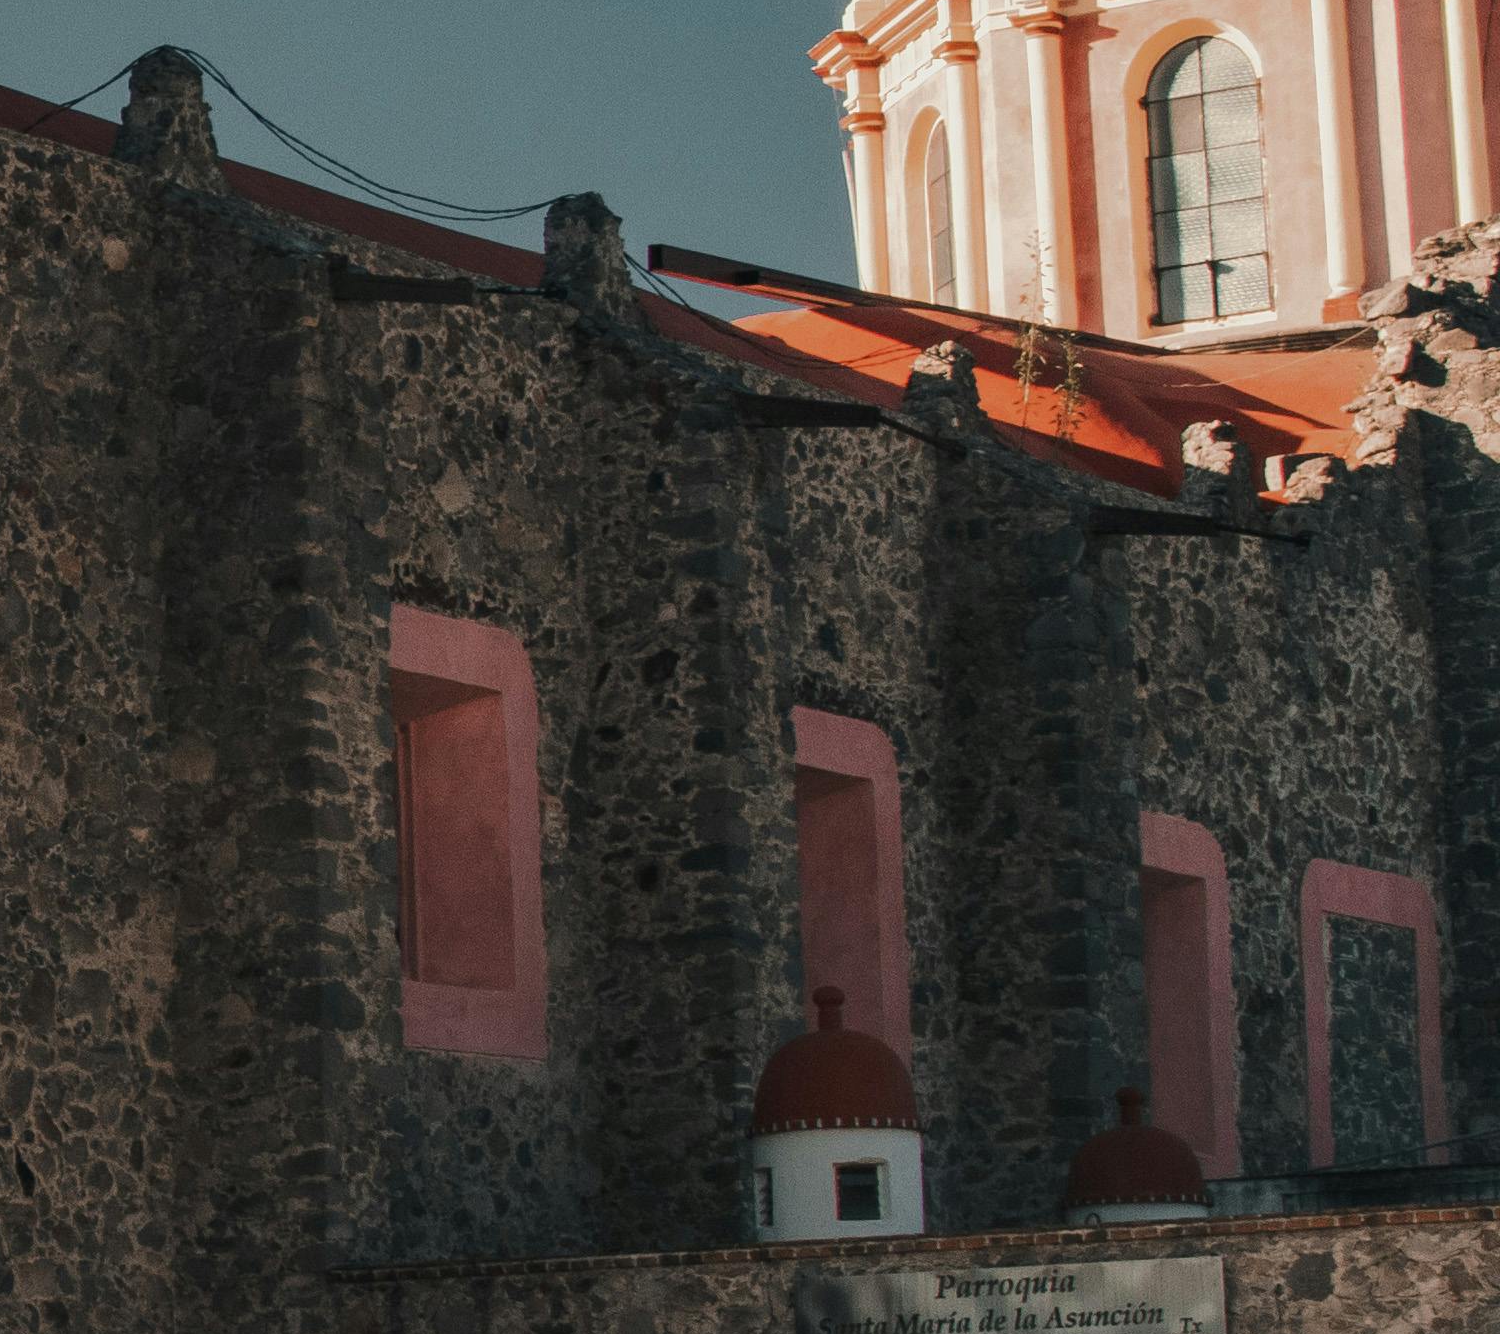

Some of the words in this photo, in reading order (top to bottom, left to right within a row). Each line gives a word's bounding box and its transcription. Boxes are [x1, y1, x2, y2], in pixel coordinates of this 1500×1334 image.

[934, 1268, 1077, 1304] Parroquia
[978, 1308, 1007, 1334] de
[1013, 1307, 1037, 1332] la
[1042, 1301, 1165, 1330] Asunción
